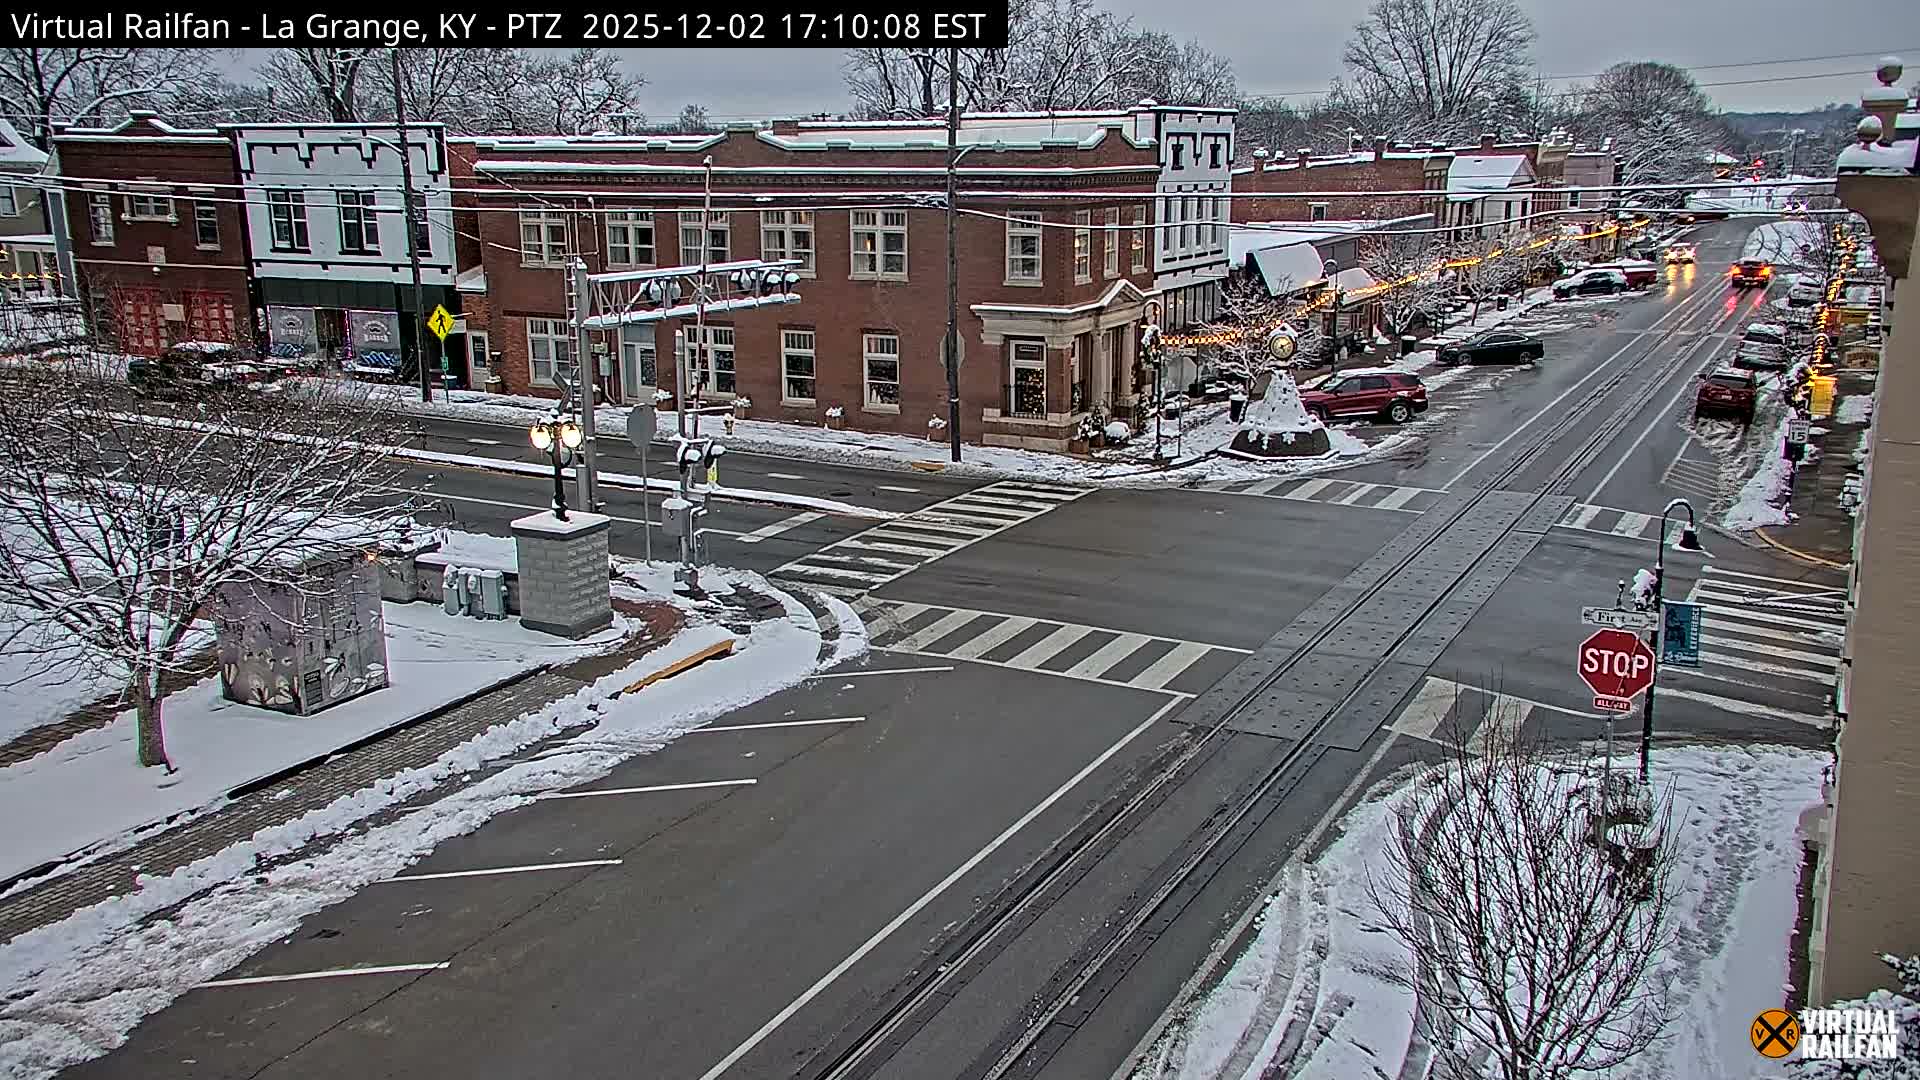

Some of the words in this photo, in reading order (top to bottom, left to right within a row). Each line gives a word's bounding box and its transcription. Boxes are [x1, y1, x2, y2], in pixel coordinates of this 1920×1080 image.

[1791, 431, 1806, 442] 15
[1597, 611, 1626, 623] Firt
[1583, 648, 1649, 679] STOP
